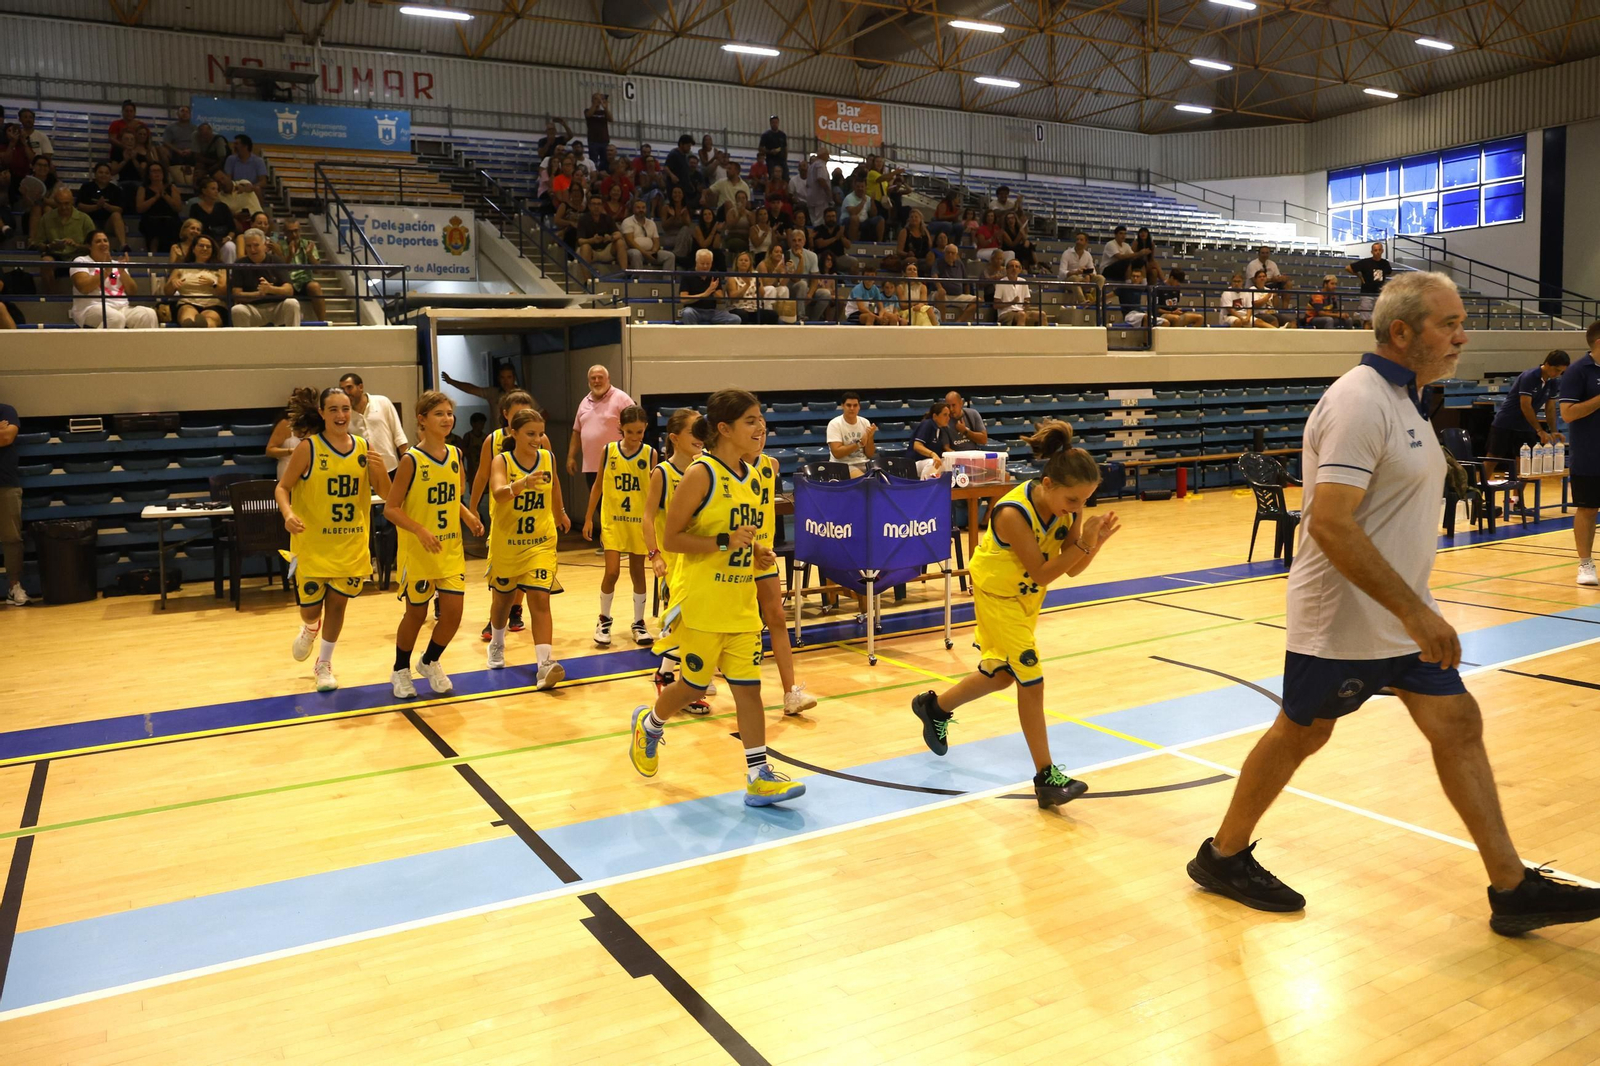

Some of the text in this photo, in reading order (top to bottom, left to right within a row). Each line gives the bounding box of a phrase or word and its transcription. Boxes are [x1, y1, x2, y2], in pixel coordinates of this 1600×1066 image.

[625, 82, 634, 100] C
[837, 101, 861, 117] Bar
[301, 121, 347, 131] Ayuntamiento
[310, 129, 347, 138] Algeciras
[818, 115, 879, 135] Cafetería
[1036, 125, 1044, 141] D
[371, 219, 436, 234] Delegación
[369, 234, 439, 248] de Deportes
[413, 264, 424, 273] de
[426, 263, 470, 275] Algeciras
[327, 474, 359, 498] CBA
[614, 472, 641, 492] CBA
[427, 481, 456, 506] CBA
[513, 491, 545, 512] CBA
[331, 503, 355, 522] 53
[620, 496, 631, 513] 4
[437, 510, 448, 529] 5
[516, 516, 536, 535] 18
[805, 518, 852, 539] molten
[883, 517, 937, 539] molten
[322, 525, 364, 535] ALGECIRAS
[507, 535, 548, 546] ALGECIRAS
[728, 543, 753, 568] 22
[535, 569, 548, 580] 18
